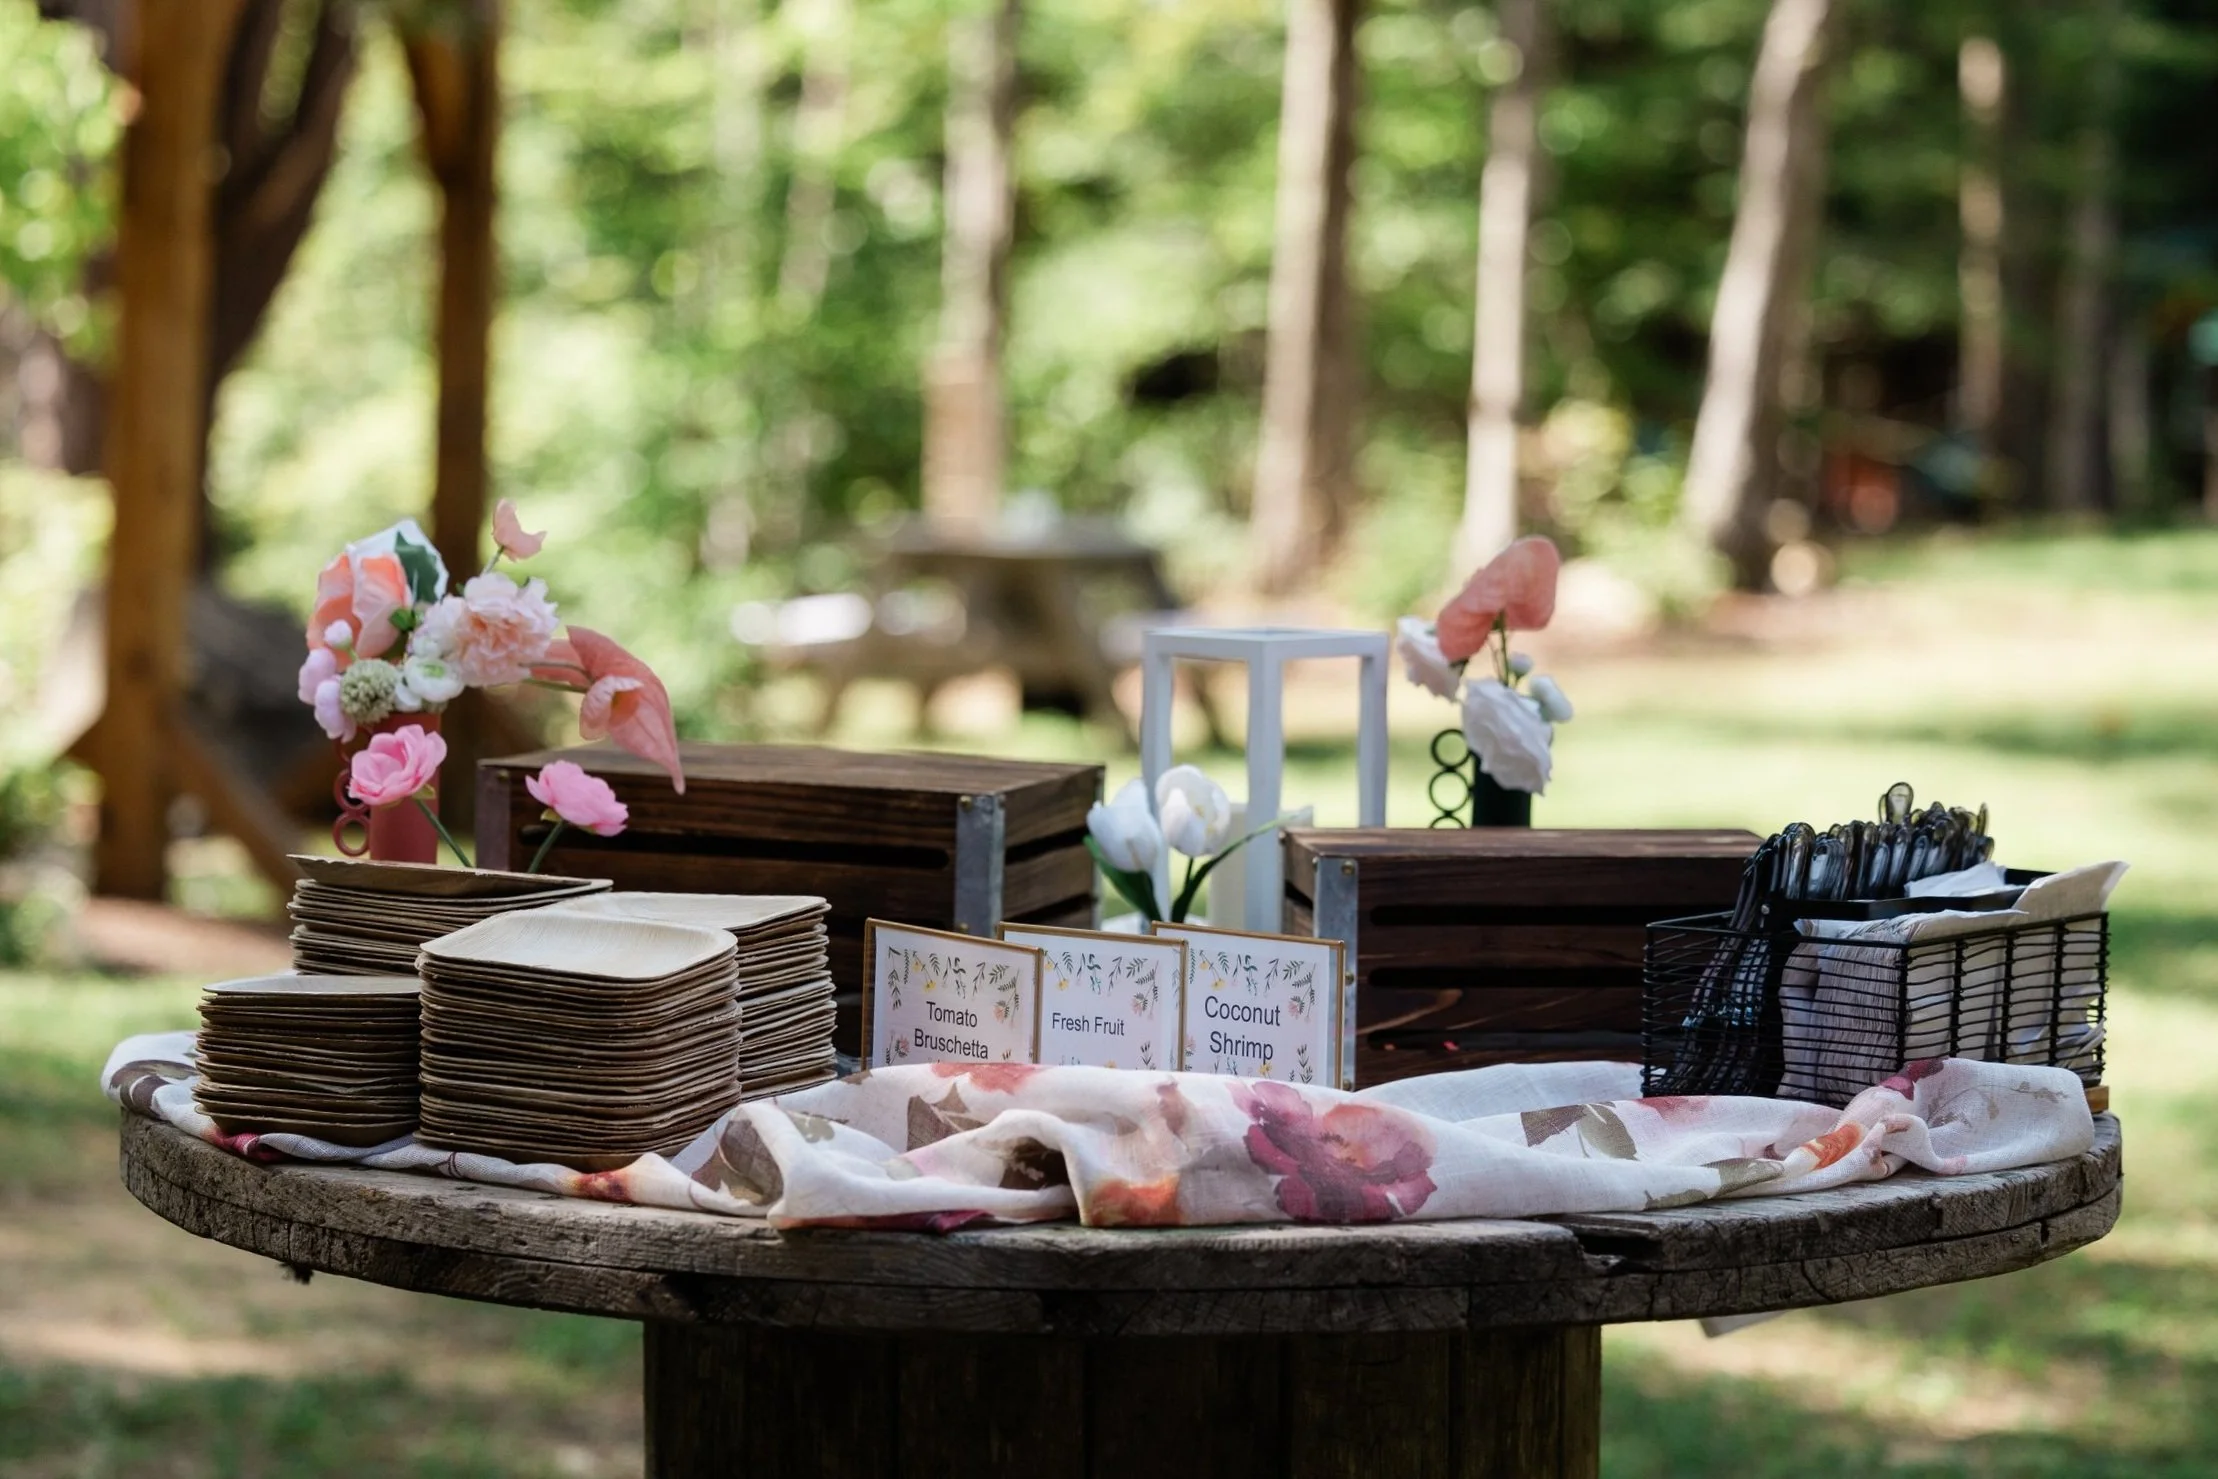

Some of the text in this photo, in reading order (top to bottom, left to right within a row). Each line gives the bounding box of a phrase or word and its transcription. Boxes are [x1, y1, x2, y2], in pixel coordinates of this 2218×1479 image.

[926, 1001, 978, 1028] Tomato
[1052, 1013, 1125, 1036] Fresh Fruit
[1204, 996, 1281, 1027] Coconut
[914, 1028, 989, 1060] Bruschetta
[1210, 1031, 1274, 1066] Shrimp
